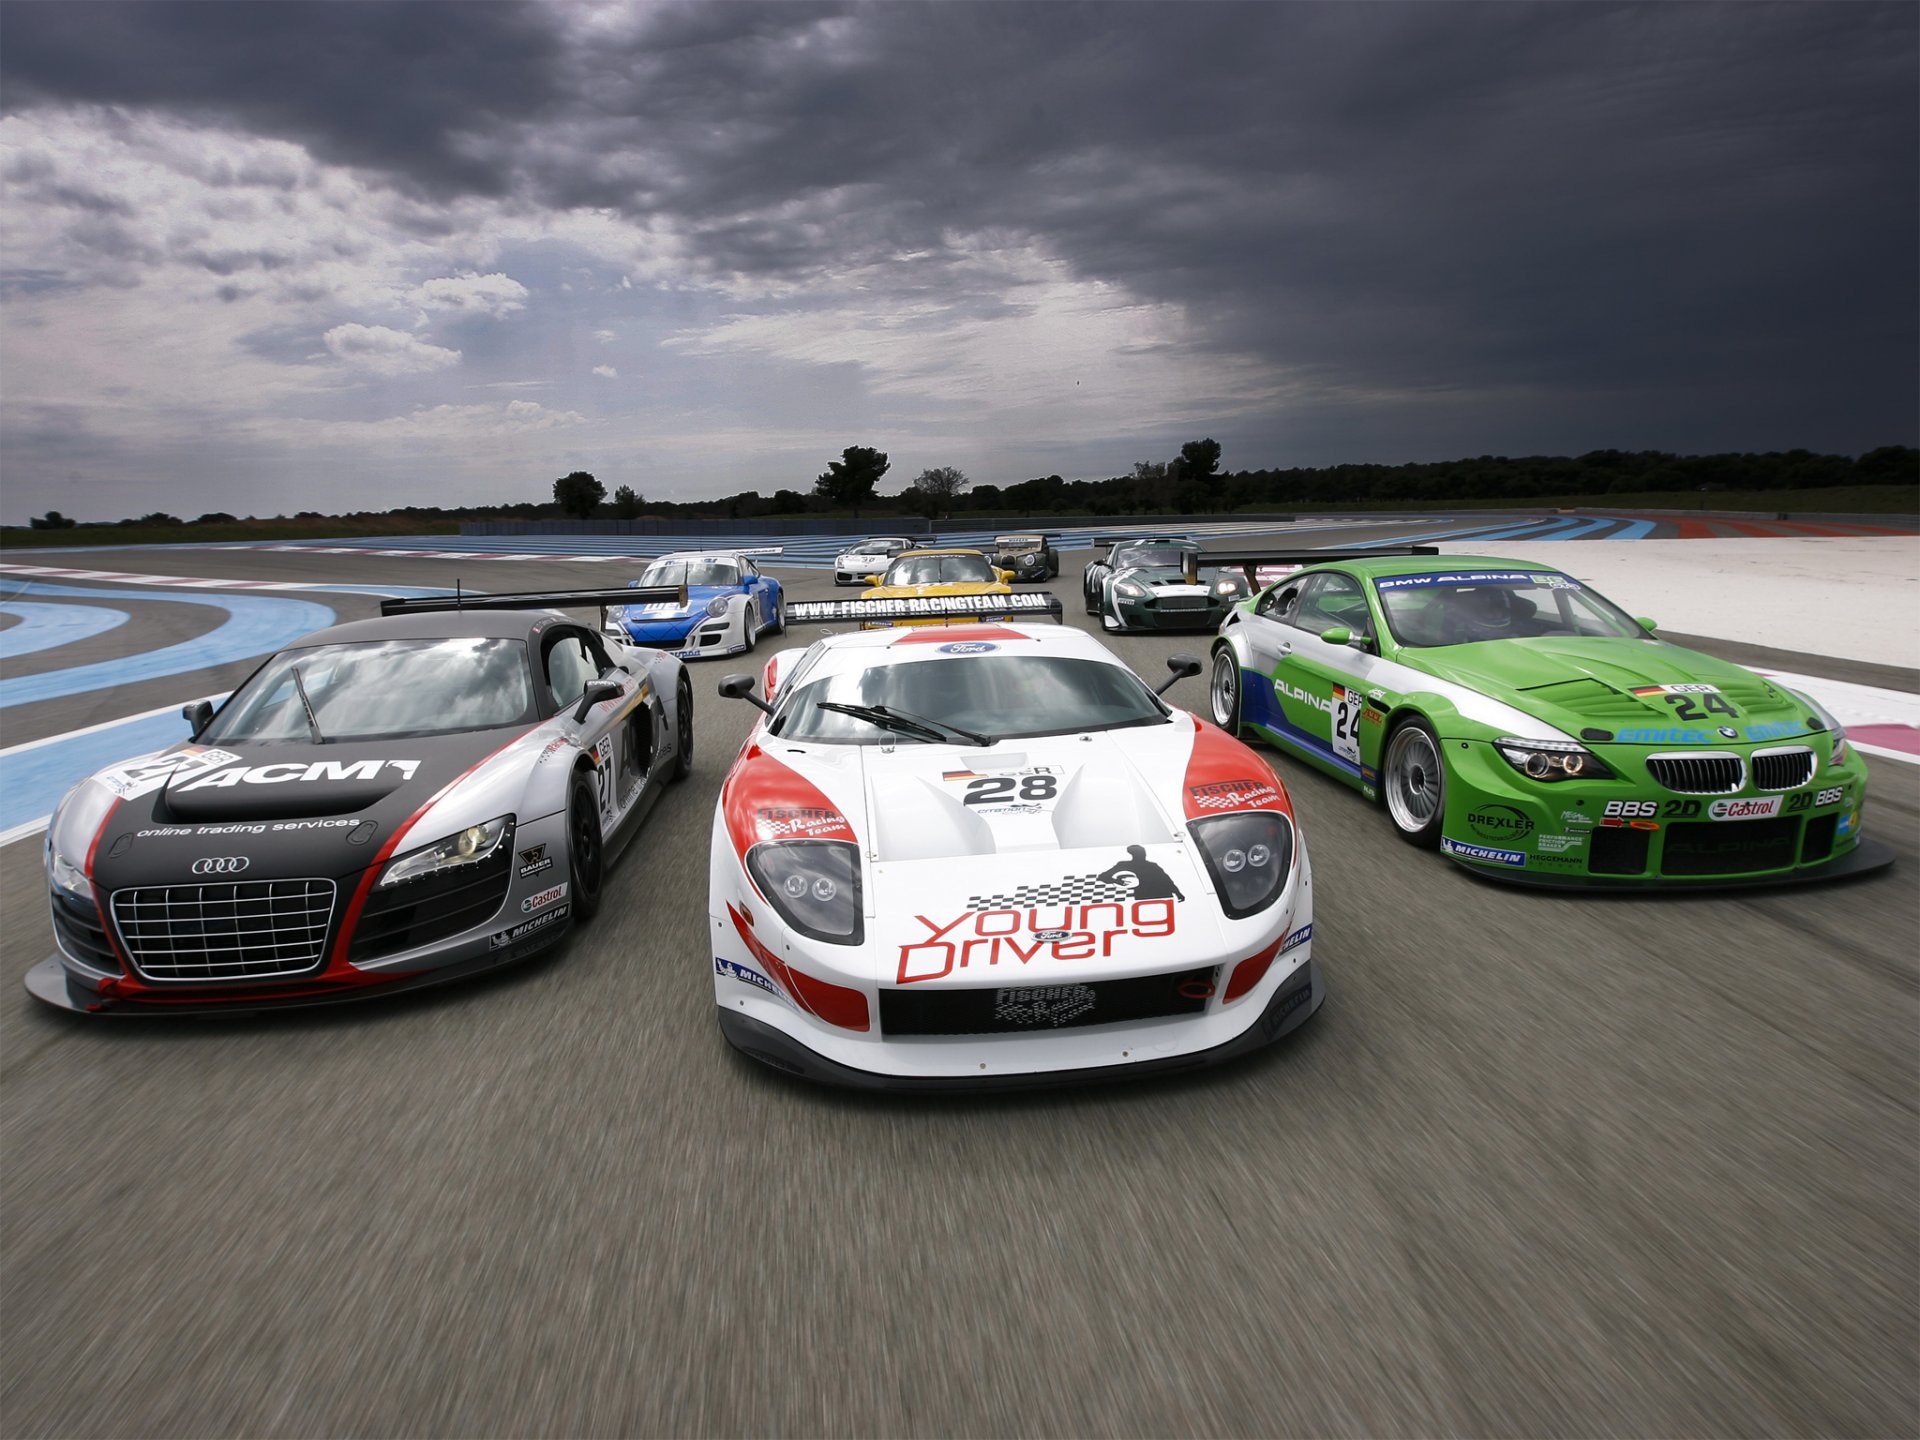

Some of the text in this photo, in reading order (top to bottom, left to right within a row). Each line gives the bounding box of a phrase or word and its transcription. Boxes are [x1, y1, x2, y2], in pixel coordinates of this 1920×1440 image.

[1379, 577, 1432, 589] BMW
[1437, 574, 1529, 583] ALPINA
[794, 592, 1047, 617] WWW.FISCHER-RACINGTEAM.COM
[949, 643, 986, 653] Ford
[1274, 678, 1332, 714] ALPINA
[1671, 684, 1714, 693] GER
[1664, 693, 1740, 722] 24
[1336, 701, 1360, 747] 24
[599, 737, 611, 757] GER
[598, 756, 611, 814] 27
[963, 775, 1058, 806] 28
[1189, 779, 1265, 797] FISCHER
[1227, 785, 1276, 806] Racing
[1247, 794, 1281, 808] Team
[1603, 786, 1844, 818] BBS 2D Castrol 2D BBS
[756, 807, 837, 820] FISCHER
[1467, 812, 1536, 831] DREXLER
[137, 818, 360, 838] online trading services
[788, 816, 845, 833] Racing
[805, 824, 847, 836] Team
[1454, 844, 1522, 863] MICHELIN
[1529, 854, 1583, 864] HEGGEMANN
[520, 859, 551, 874] BAUER
[532, 886, 563, 909] Castrol
[512, 906, 568, 938] MICHELIN
[913, 899, 1176, 944] Young
[1040, 931, 1063, 939] Ford
[896, 929, 1128, 985] Driver
